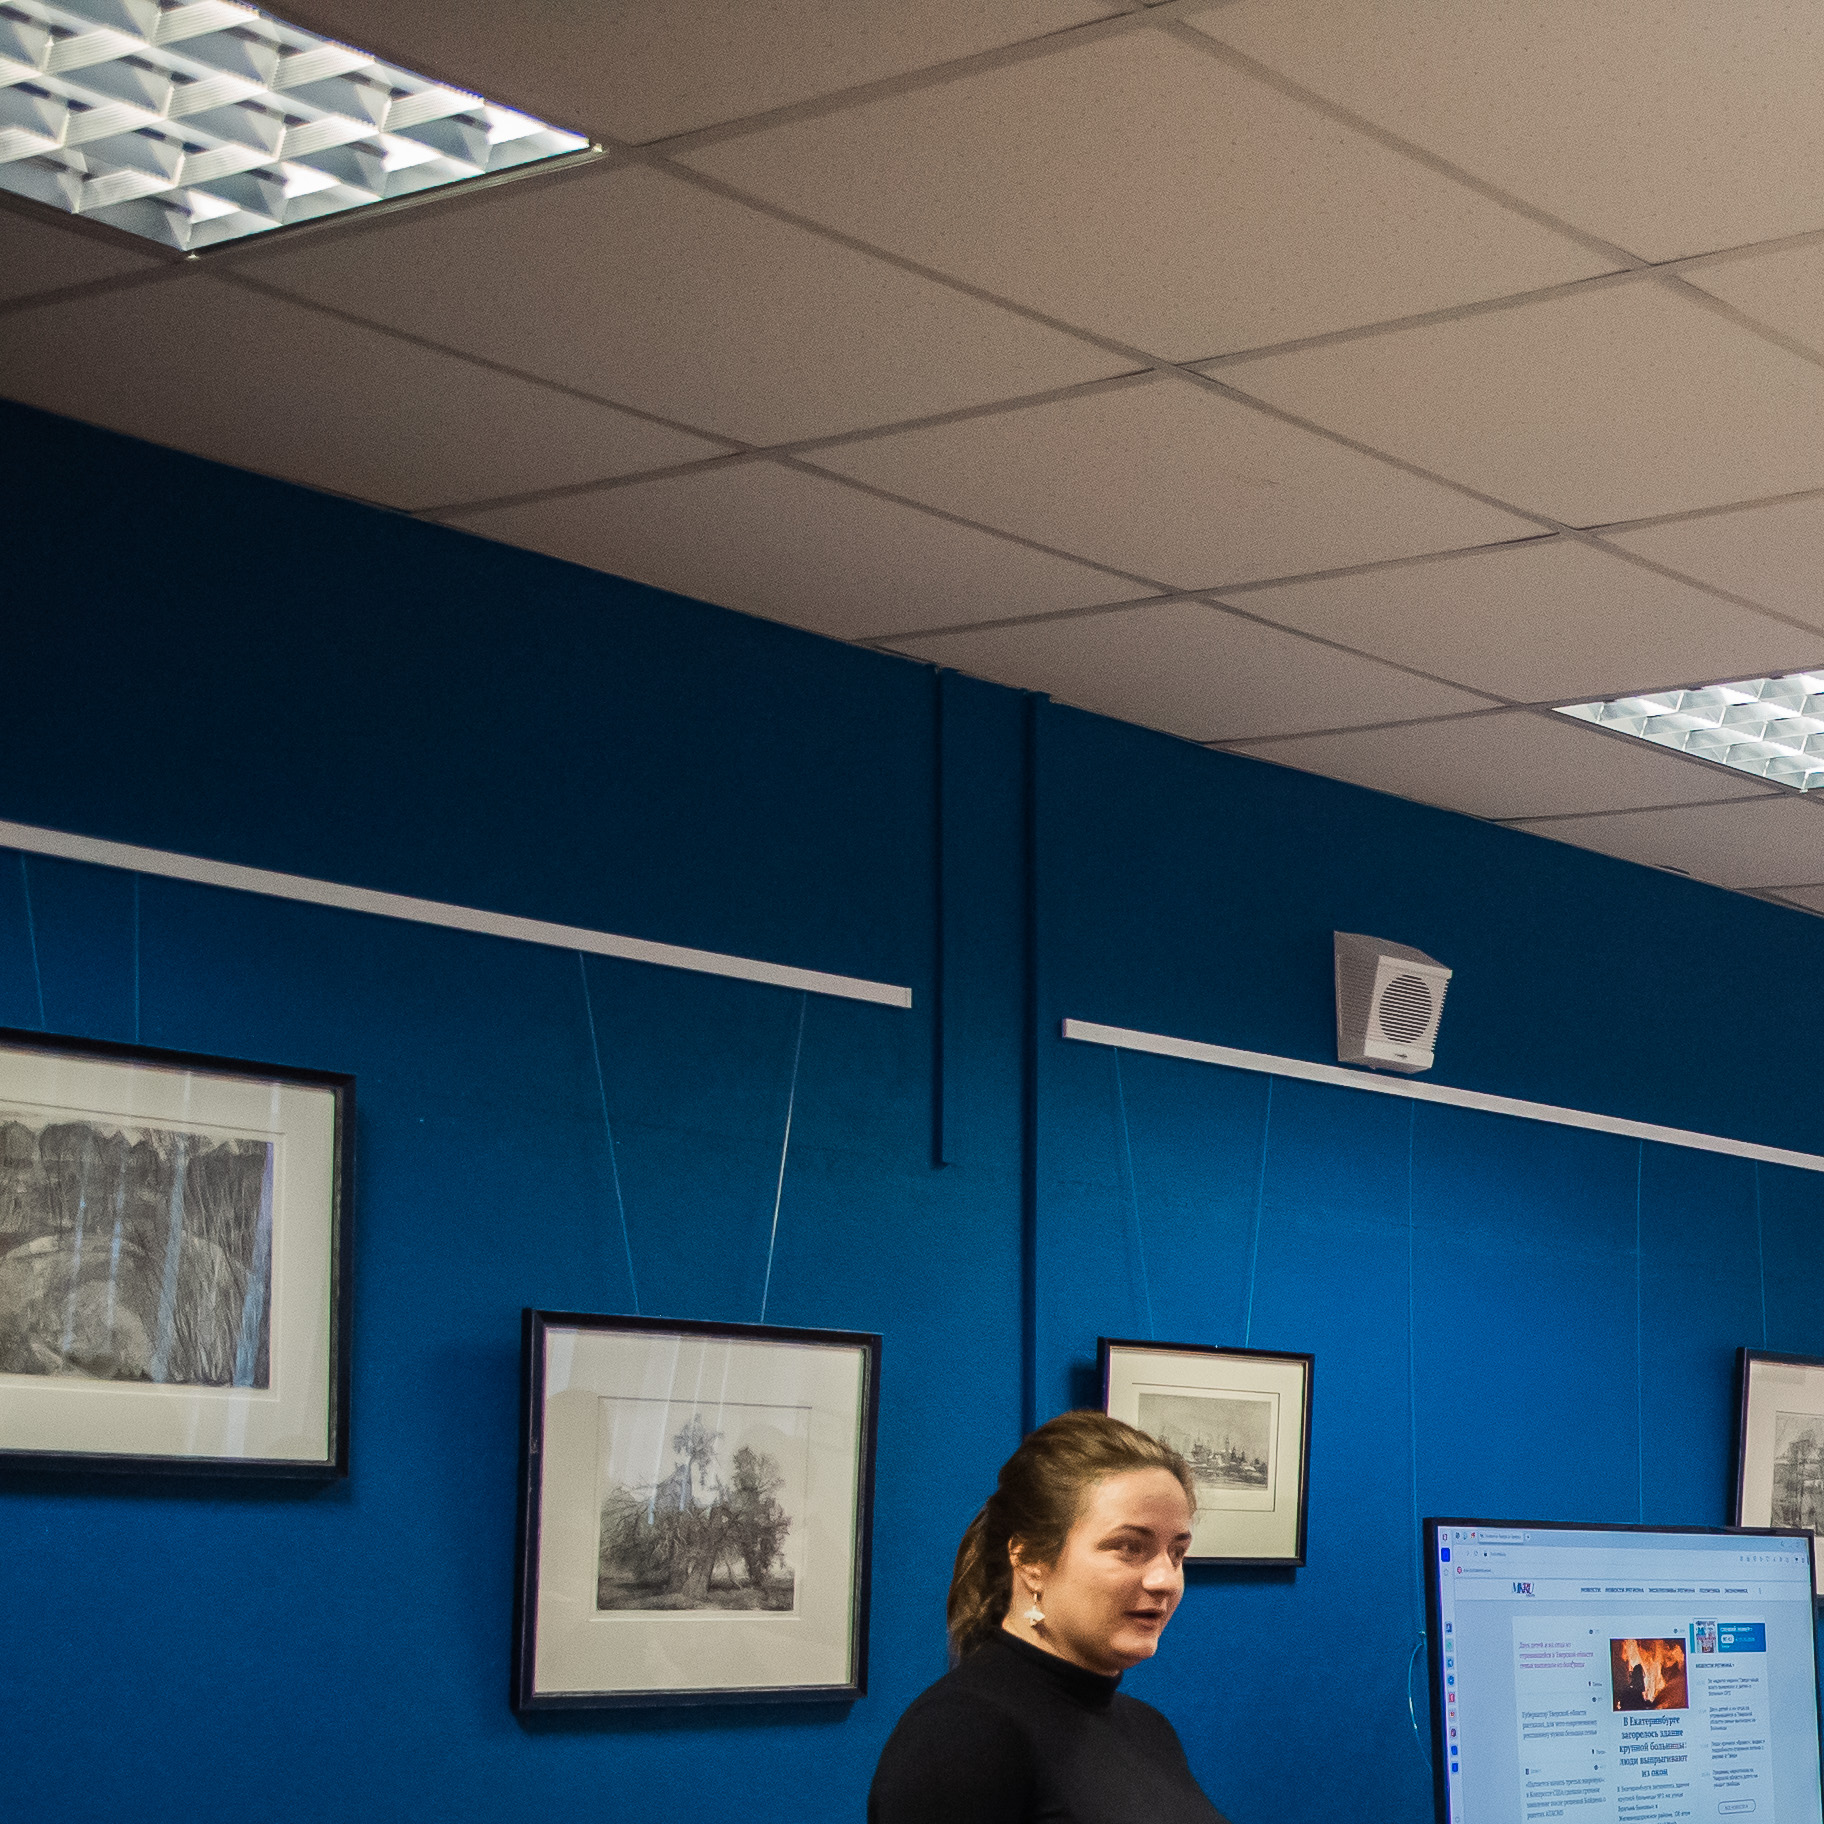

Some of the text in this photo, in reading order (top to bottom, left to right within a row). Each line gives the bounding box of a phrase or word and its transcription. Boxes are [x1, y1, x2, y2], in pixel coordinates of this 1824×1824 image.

[1630, 1715, 1680, 1727] Екатеринбурге
[1621, 1731, 1659, 1741] загорелось
[1619, 1742, 1648, 1754] крупной
